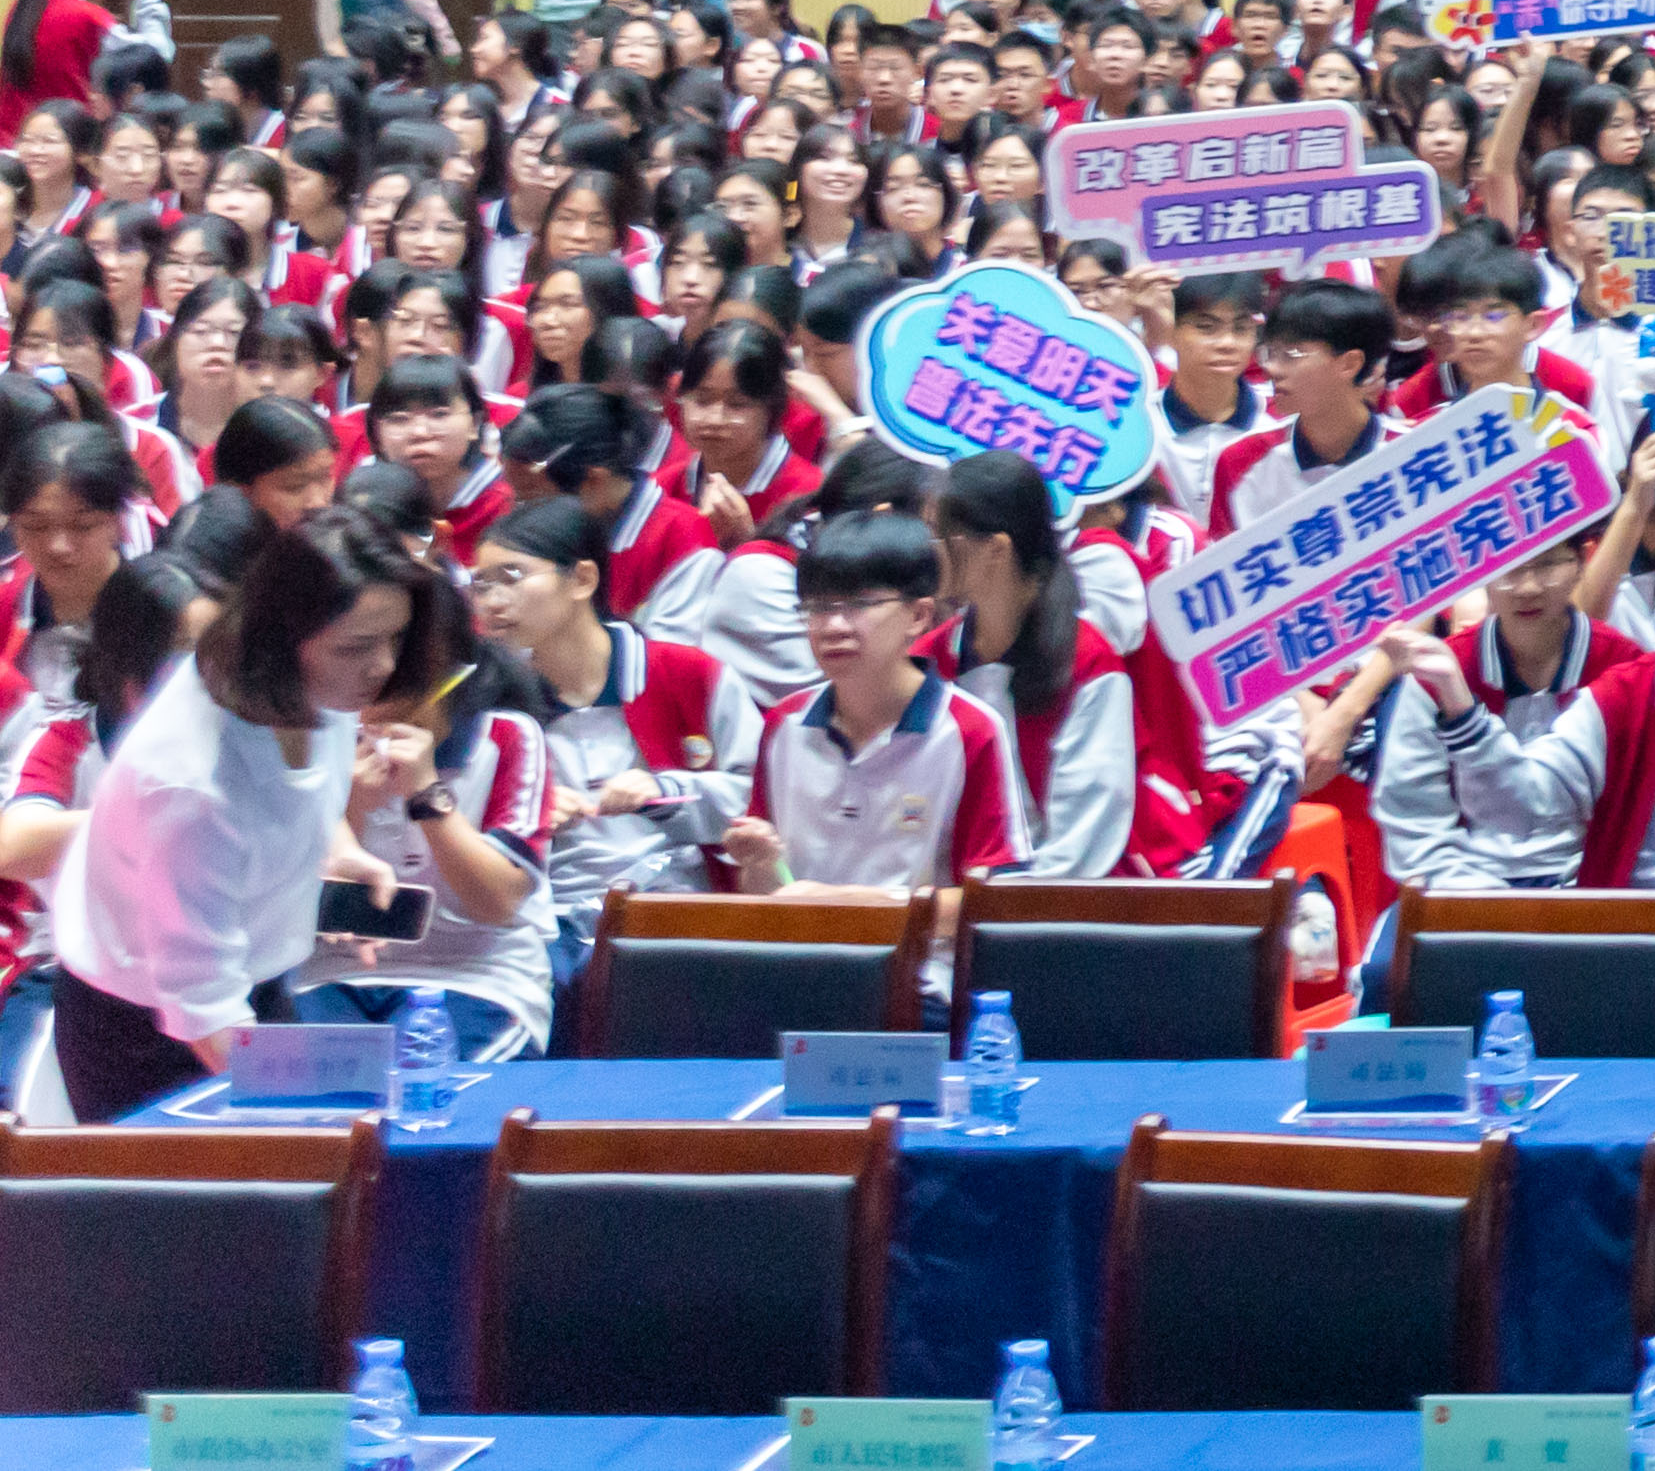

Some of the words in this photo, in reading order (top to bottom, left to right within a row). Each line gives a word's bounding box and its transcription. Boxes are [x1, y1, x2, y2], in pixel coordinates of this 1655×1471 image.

[1074, 126, 1347, 193] 改革启新篇
[1151, 181, 1422, 248] 宪法筑根基
[904, 356, 1108, 491] 普法先行
[936, 291, 1140, 429] 关爱明天
[1175, 410, 1521, 635] 切实尊崇宪法
[1213, 459, 1584, 710] 严格实施宪法
